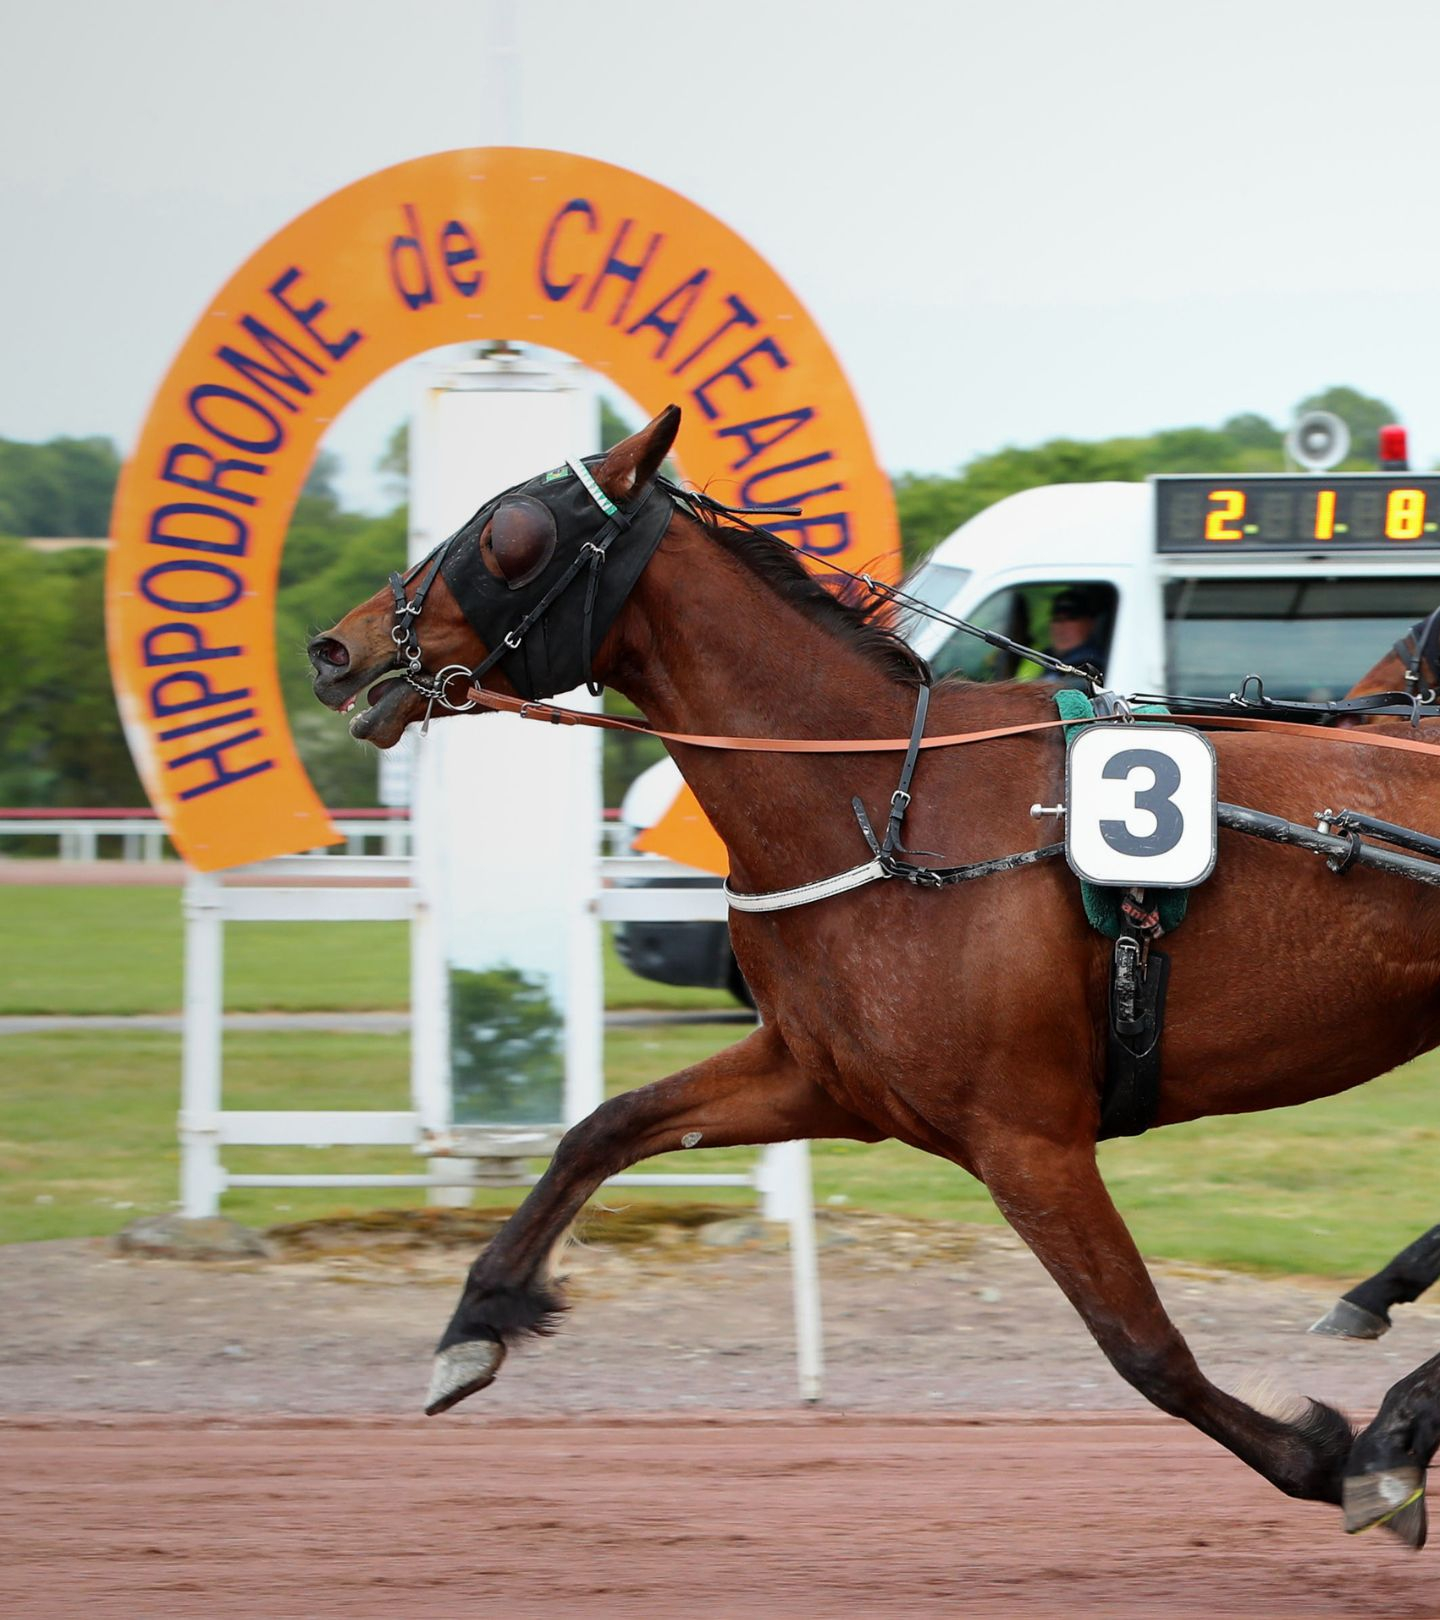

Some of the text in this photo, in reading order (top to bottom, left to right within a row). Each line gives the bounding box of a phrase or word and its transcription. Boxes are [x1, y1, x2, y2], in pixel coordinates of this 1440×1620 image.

[137, 267, 363, 801] HIPPODROME
[389, 204, 487, 311] de
[1314, 490, 1336, 540] 1
[1385, 489, 1426, 540] 8
[1099, 748, 1184, 857] 3
